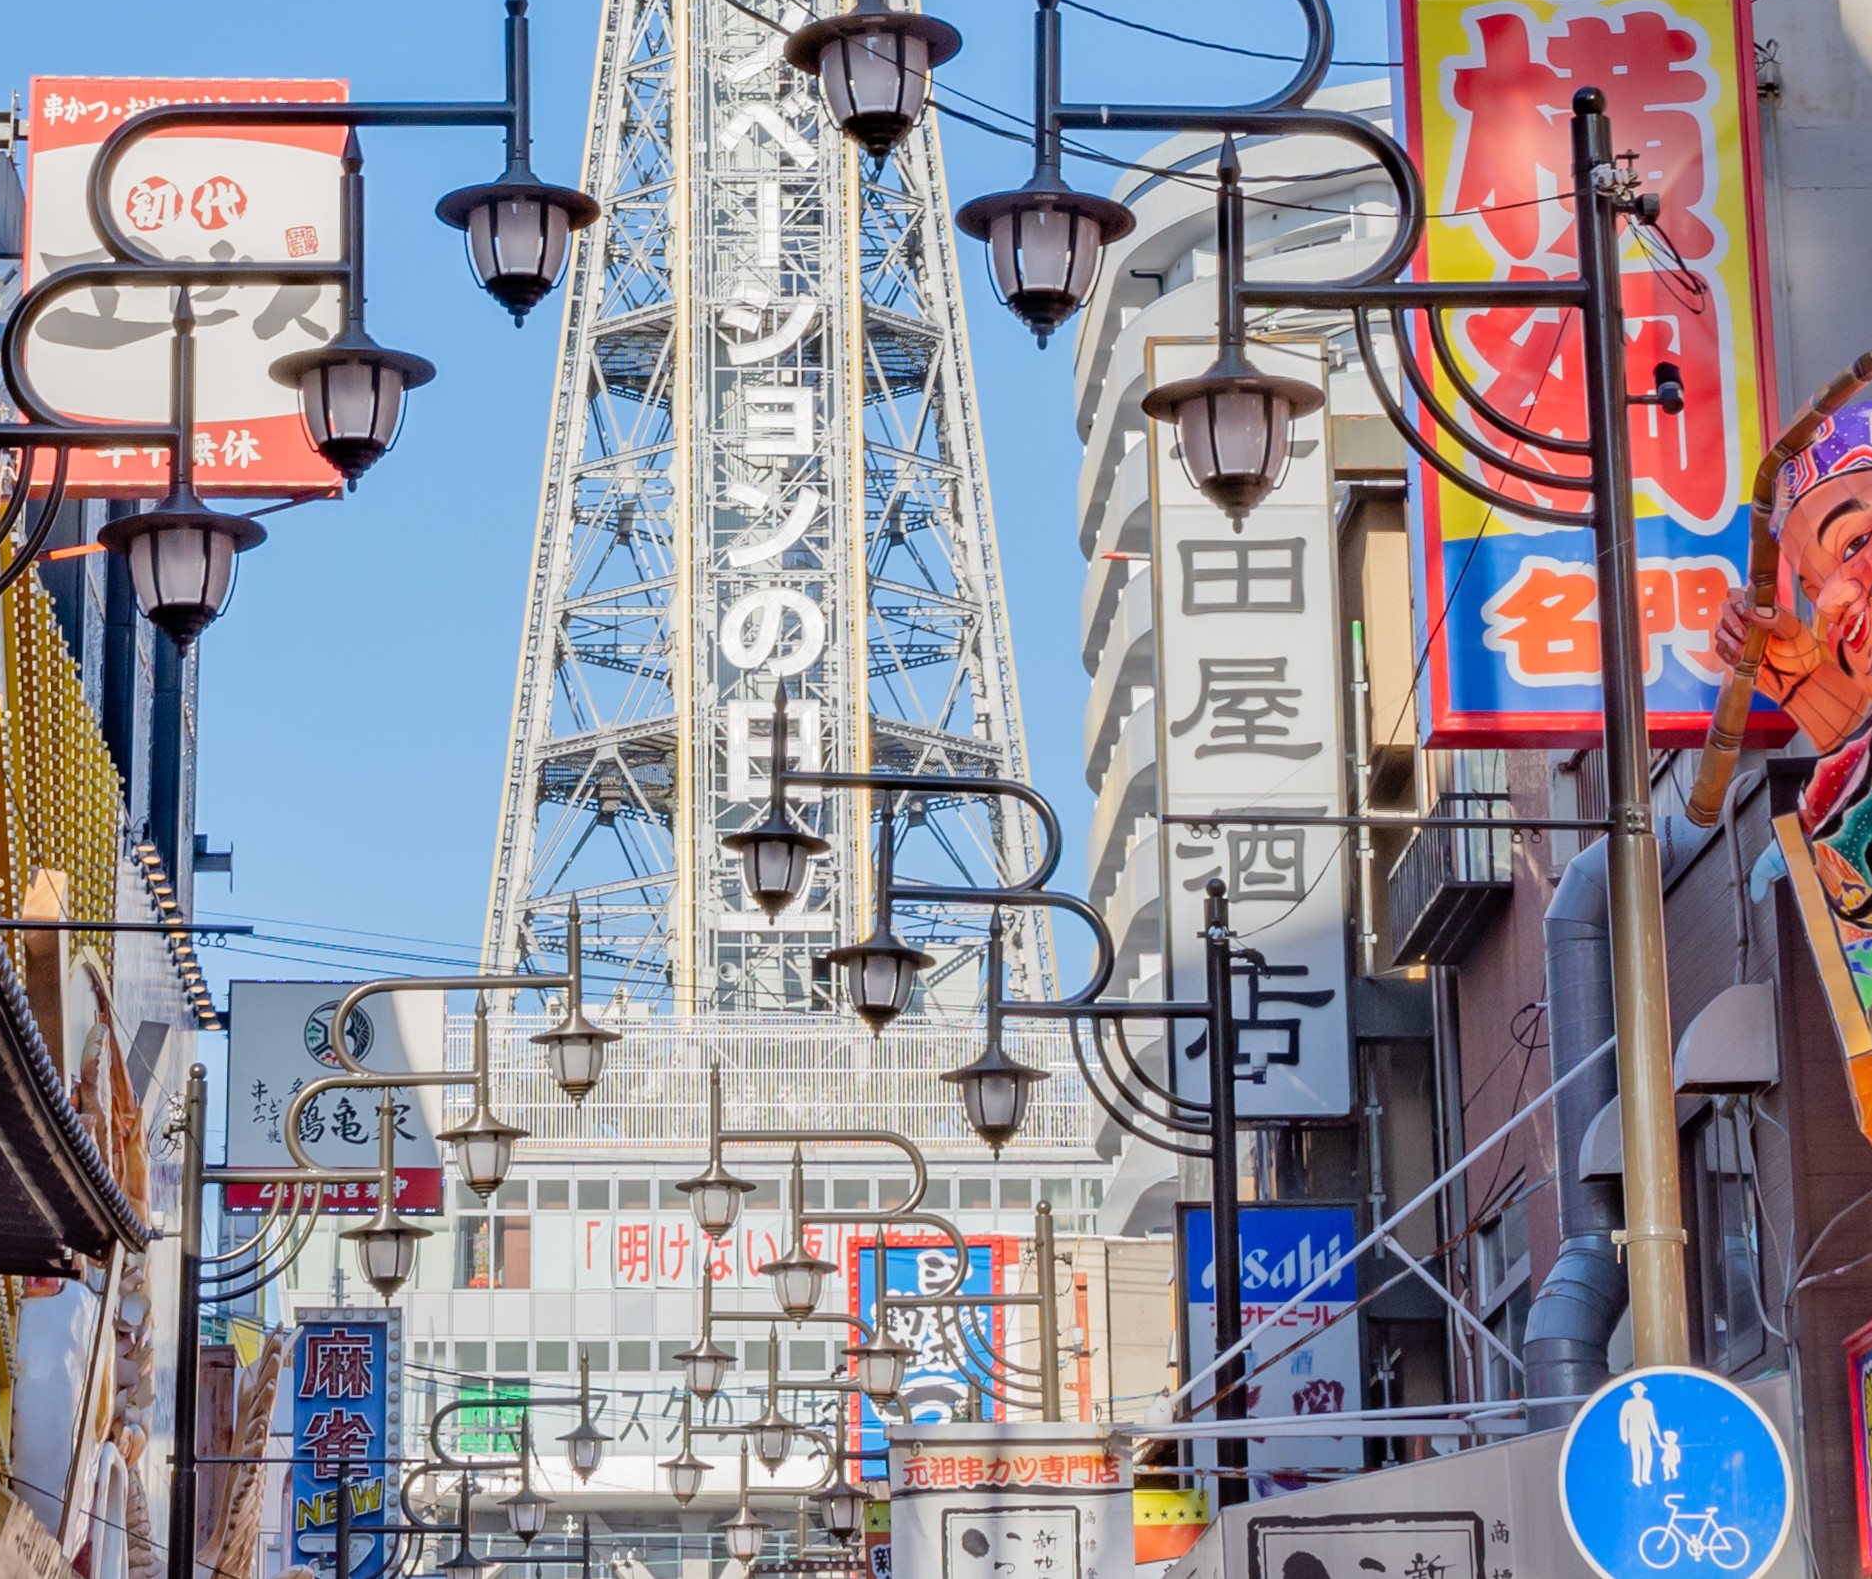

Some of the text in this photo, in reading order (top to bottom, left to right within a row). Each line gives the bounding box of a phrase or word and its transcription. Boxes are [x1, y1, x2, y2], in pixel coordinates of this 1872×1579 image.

[127, 177, 247, 230] 初代
[1454, 10, 1724, 521] 横綱
[1492, 567, 1725, 677] 名門
[1170, 438, 1335, 1066] 田屋酒店
[299, 1327, 376, 1479] 麻雀
[296, 1476, 385, 1531] NEW
[902, 1454, 1121, 1487] 元祖串カツ専門店
